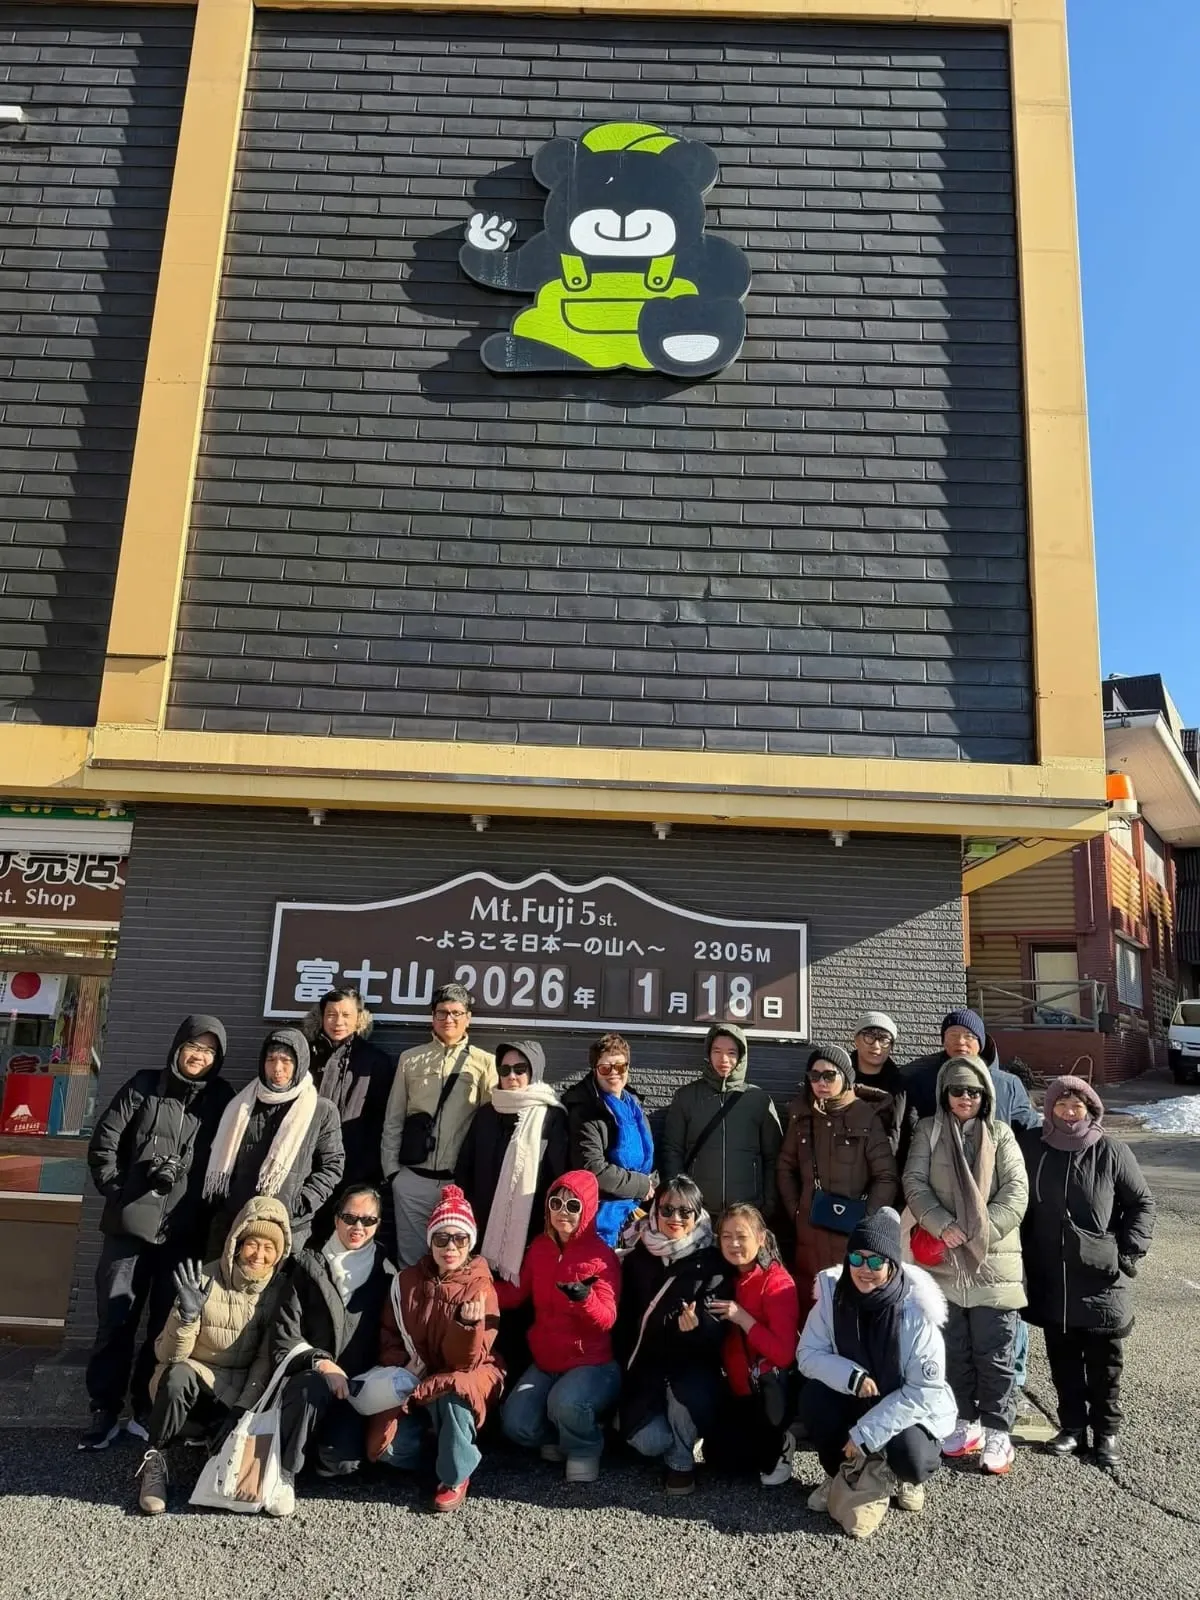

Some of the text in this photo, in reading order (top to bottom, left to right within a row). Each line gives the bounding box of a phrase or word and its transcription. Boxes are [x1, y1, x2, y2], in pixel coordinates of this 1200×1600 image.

[25, 888, 76, 911] Shop
[694, 940, 771, 963] 2305M
[294, 957, 435, 1004] 富士山
